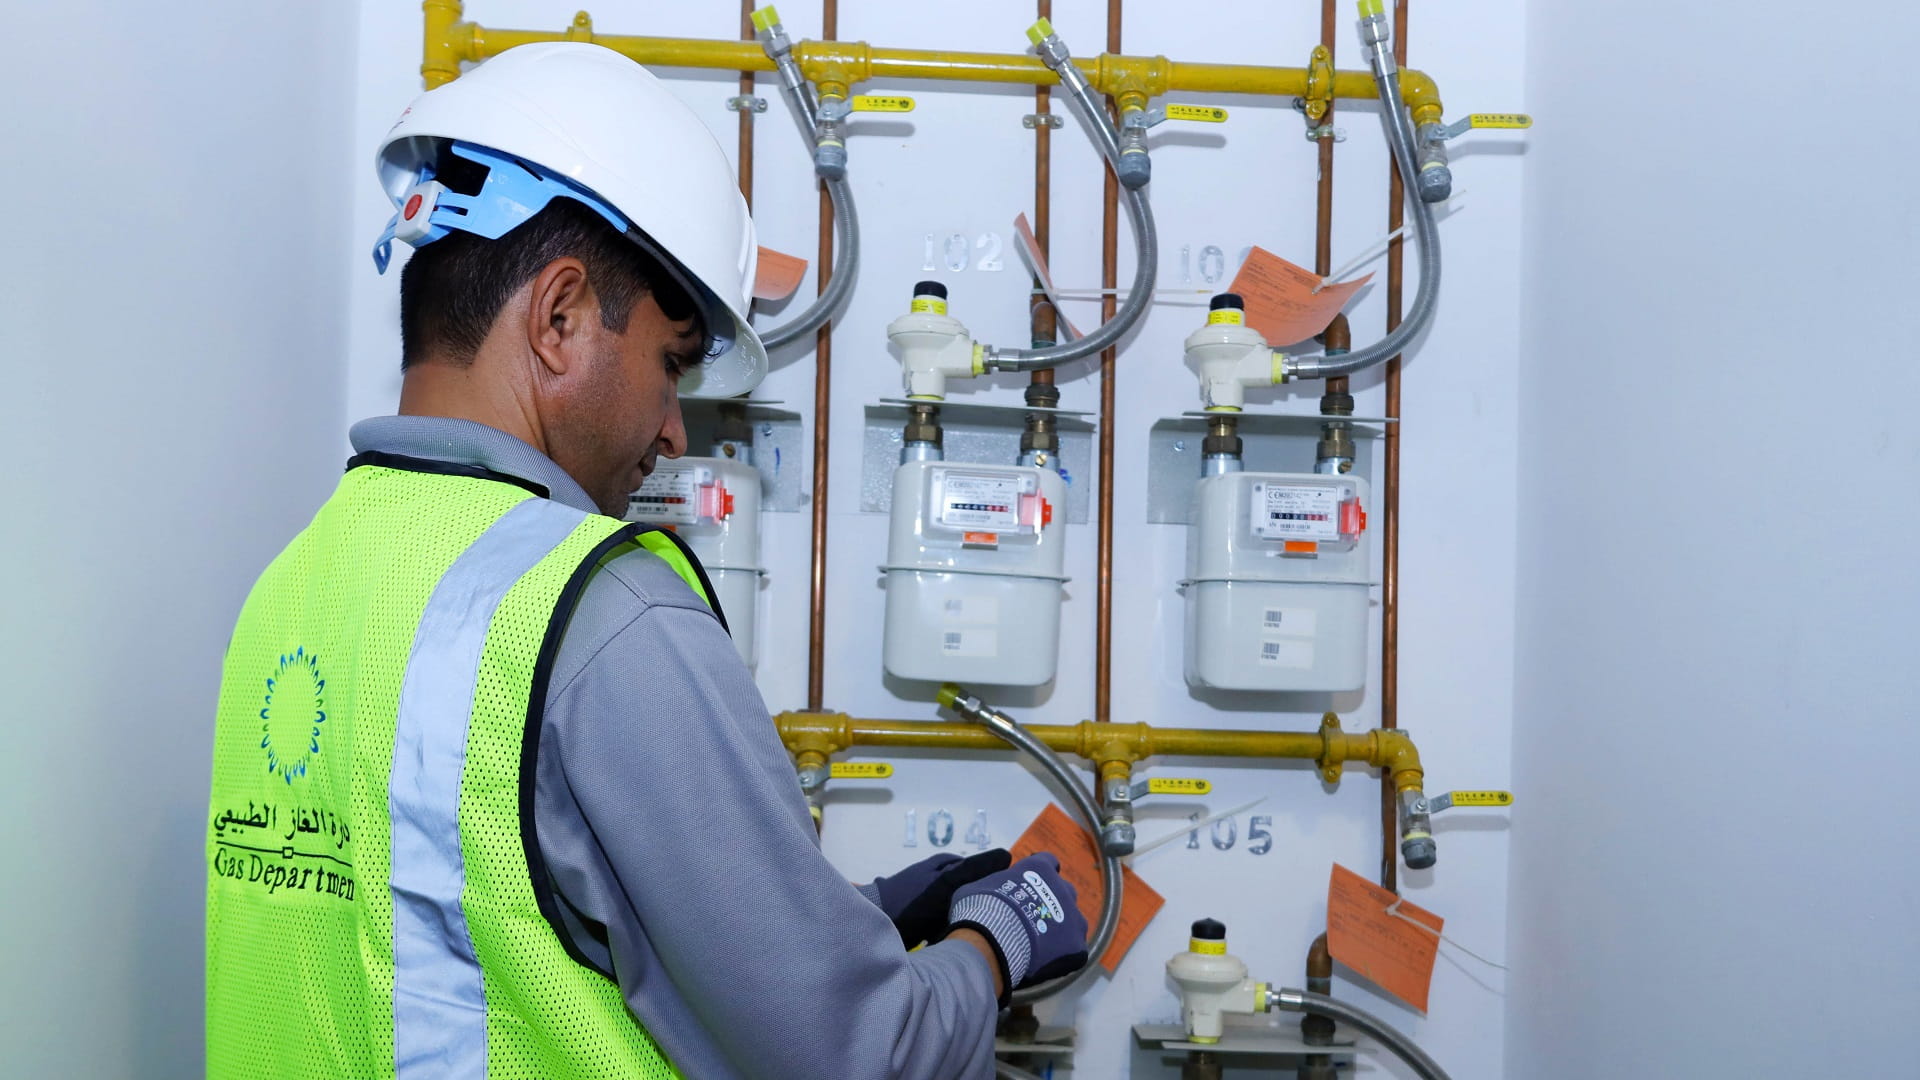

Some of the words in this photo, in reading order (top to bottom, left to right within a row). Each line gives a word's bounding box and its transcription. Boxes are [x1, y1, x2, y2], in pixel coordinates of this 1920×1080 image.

[919, 232, 1004, 272] 102
[214, 799, 277, 838] الطبيعي
[284, 805, 327, 841] الغاز
[902, 806, 992, 850] 104
[1186, 812, 1273, 856] 105
[214, 847, 245, 880] Gas
[248, 853, 355, 902] Departmen
[1020, 882, 1039, 901] ARIA
[1040, 886, 1061, 917] SKYTEC
